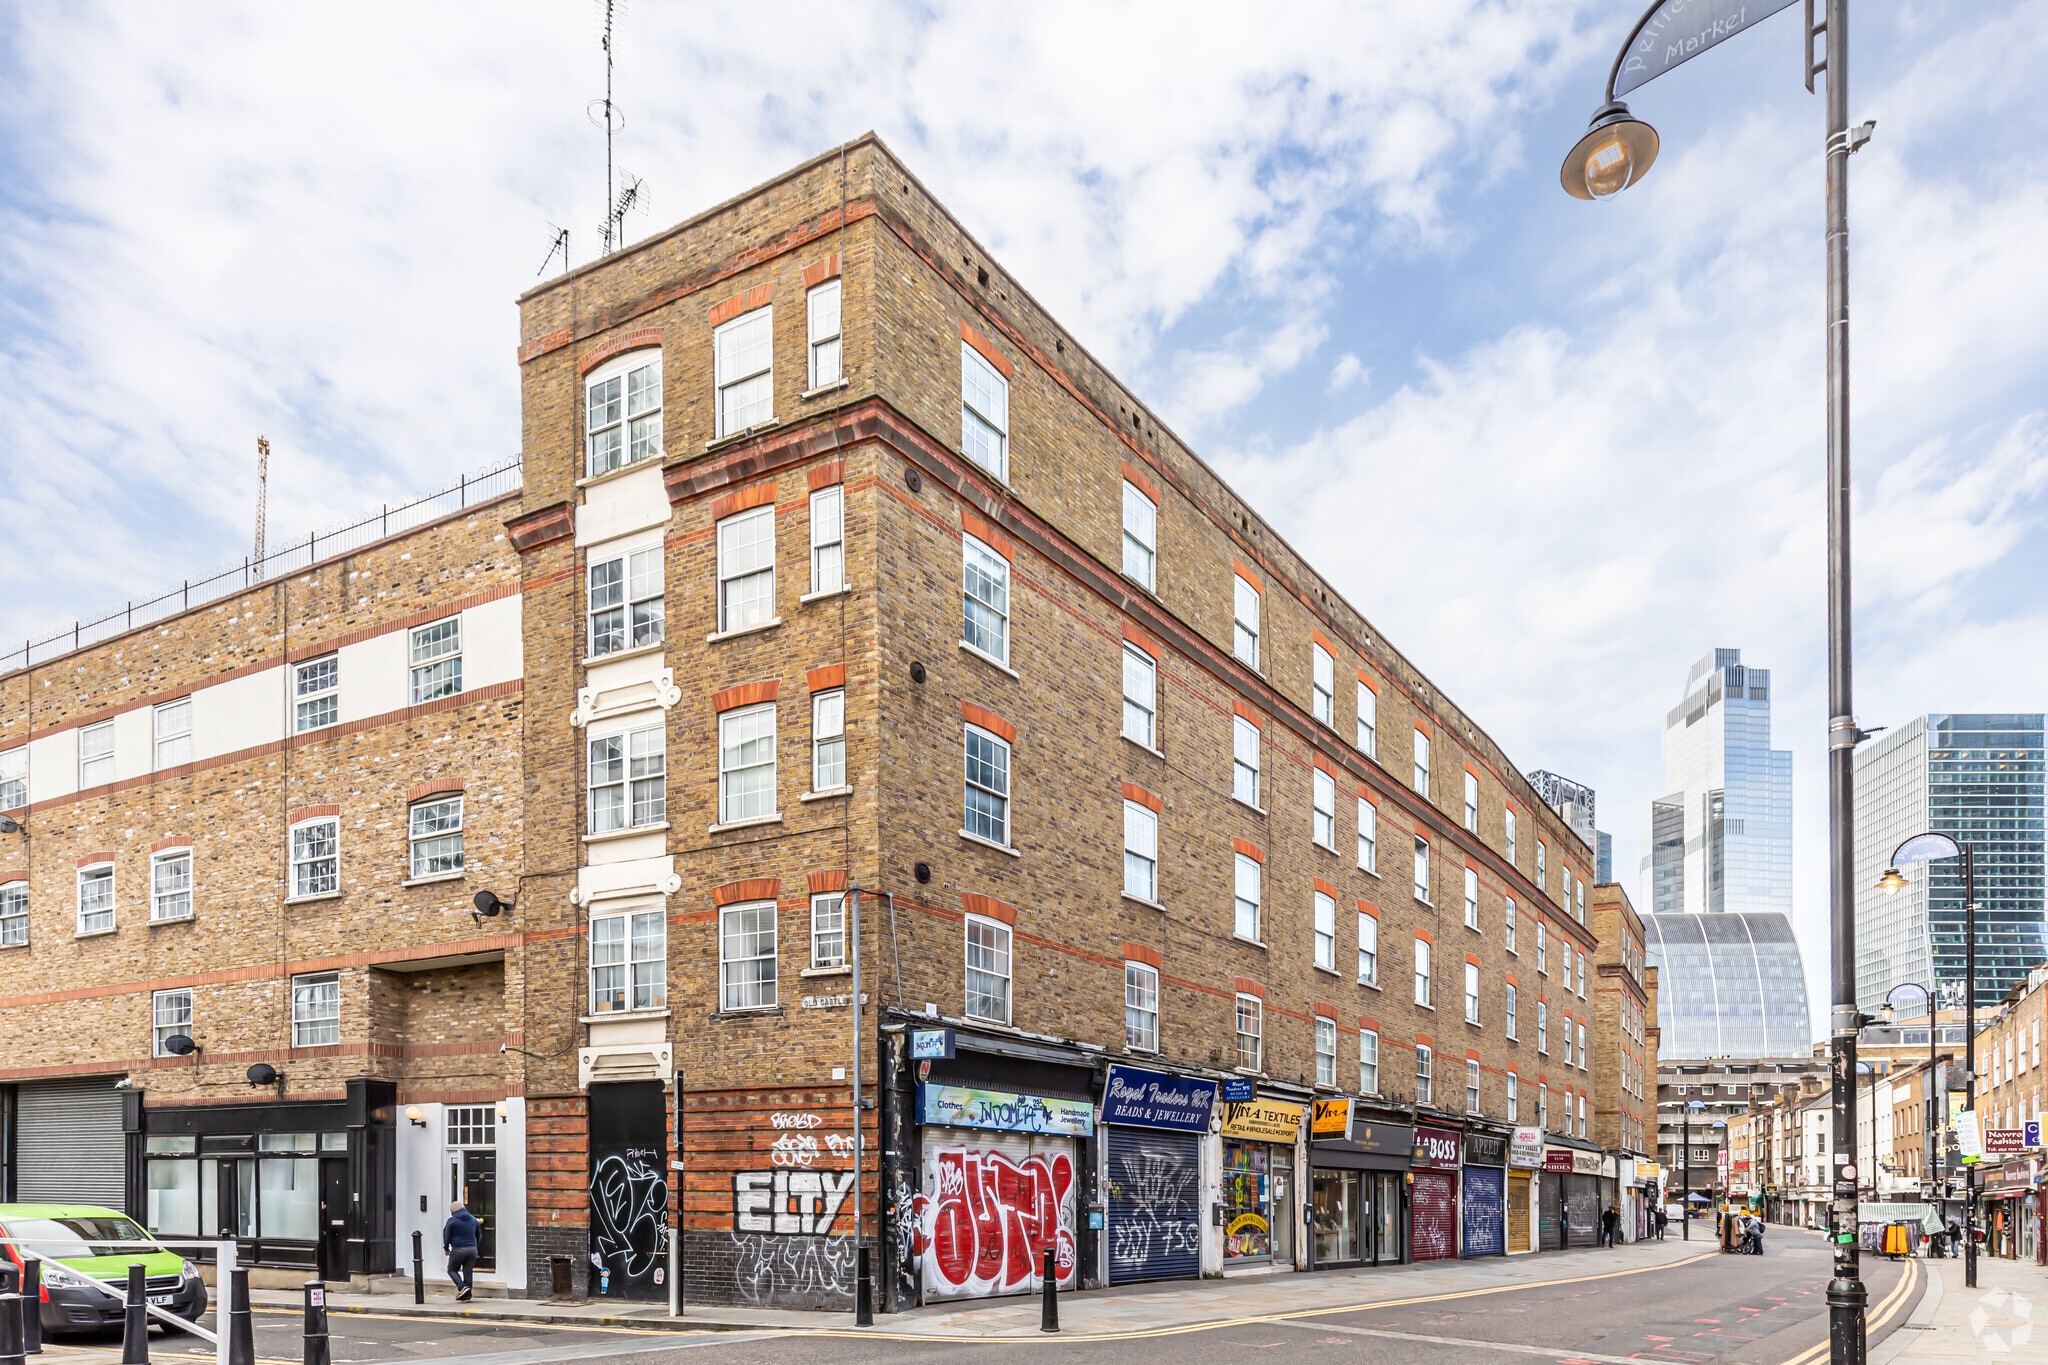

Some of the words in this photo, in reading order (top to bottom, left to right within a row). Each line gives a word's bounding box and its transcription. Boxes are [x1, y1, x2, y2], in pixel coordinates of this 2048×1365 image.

[1665, 6, 1746, 65] Market
[803, 999, 818, 1007] OLD
[820, 997, 846, 1006] CASTLE
[1109, 1077, 1147, 1104] Royal
[1149, 1083, 1189, 1107] Traders
[1191, 1088, 1213, 1109] UK
[937, 1100, 964, 1111] Clothes
[1060, 1107, 1091, 1118] Handmade
[1114, 1104, 1144, 1119] BEADS
[1144, 1107, 1152, 1119] &
[1152, 1109, 1202, 1124] JEWELLERY
[1263, 1110, 1302, 1125] TEXTILES
[1060, 1115, 1087, 1127] Jewellery
[1230, 1124, 1247, 1132] RETAIL
[1249, 1126, 1276, 1135] WHOLESALE
[1473, 1137, 1499, 1155] APEED
[150, 1296, 167, 1304] VLF
